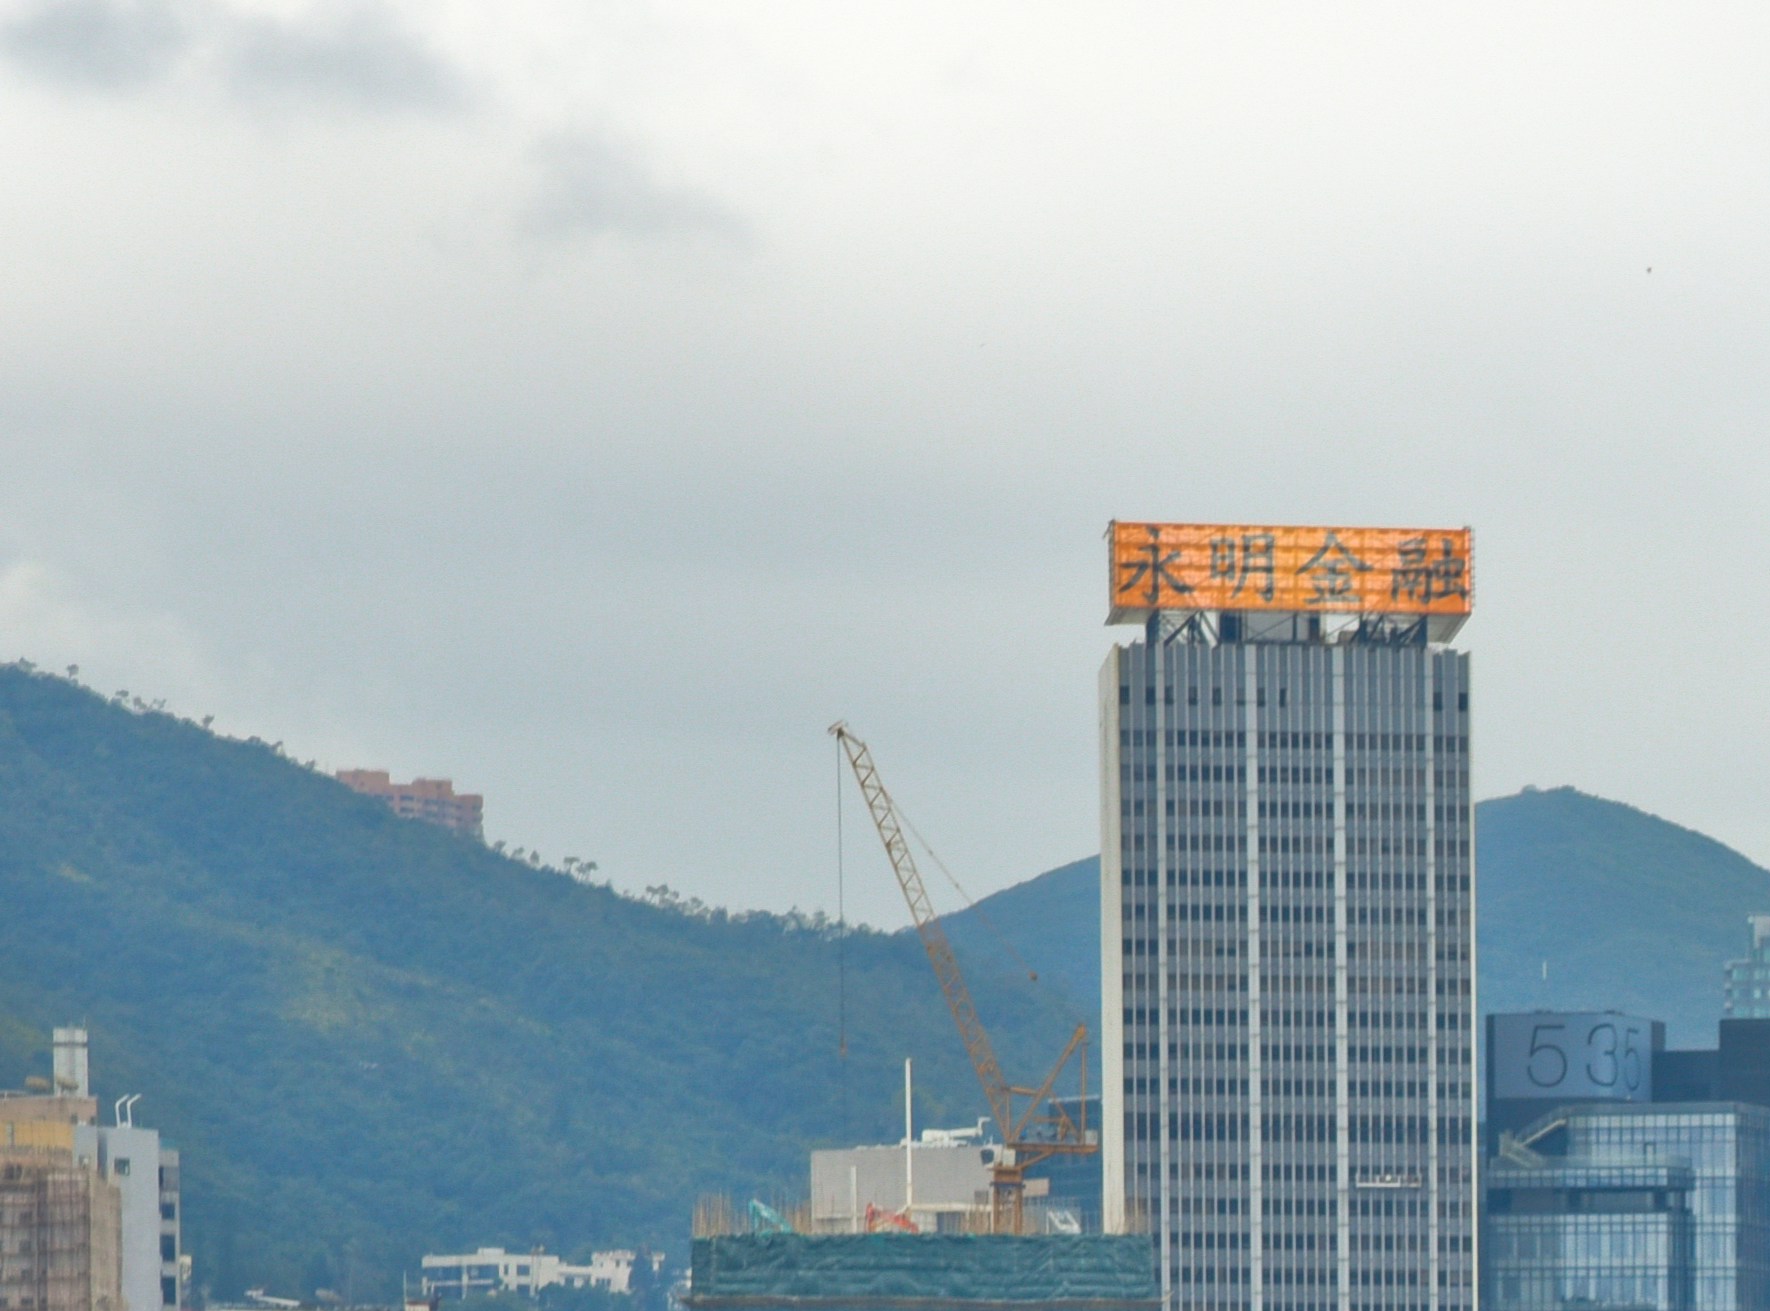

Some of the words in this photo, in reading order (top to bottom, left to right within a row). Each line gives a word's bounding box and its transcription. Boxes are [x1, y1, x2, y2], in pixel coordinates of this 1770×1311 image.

[1118, 524, 1468, 604] 永明金融
[1526, 1022, 1642, 1092] 535
